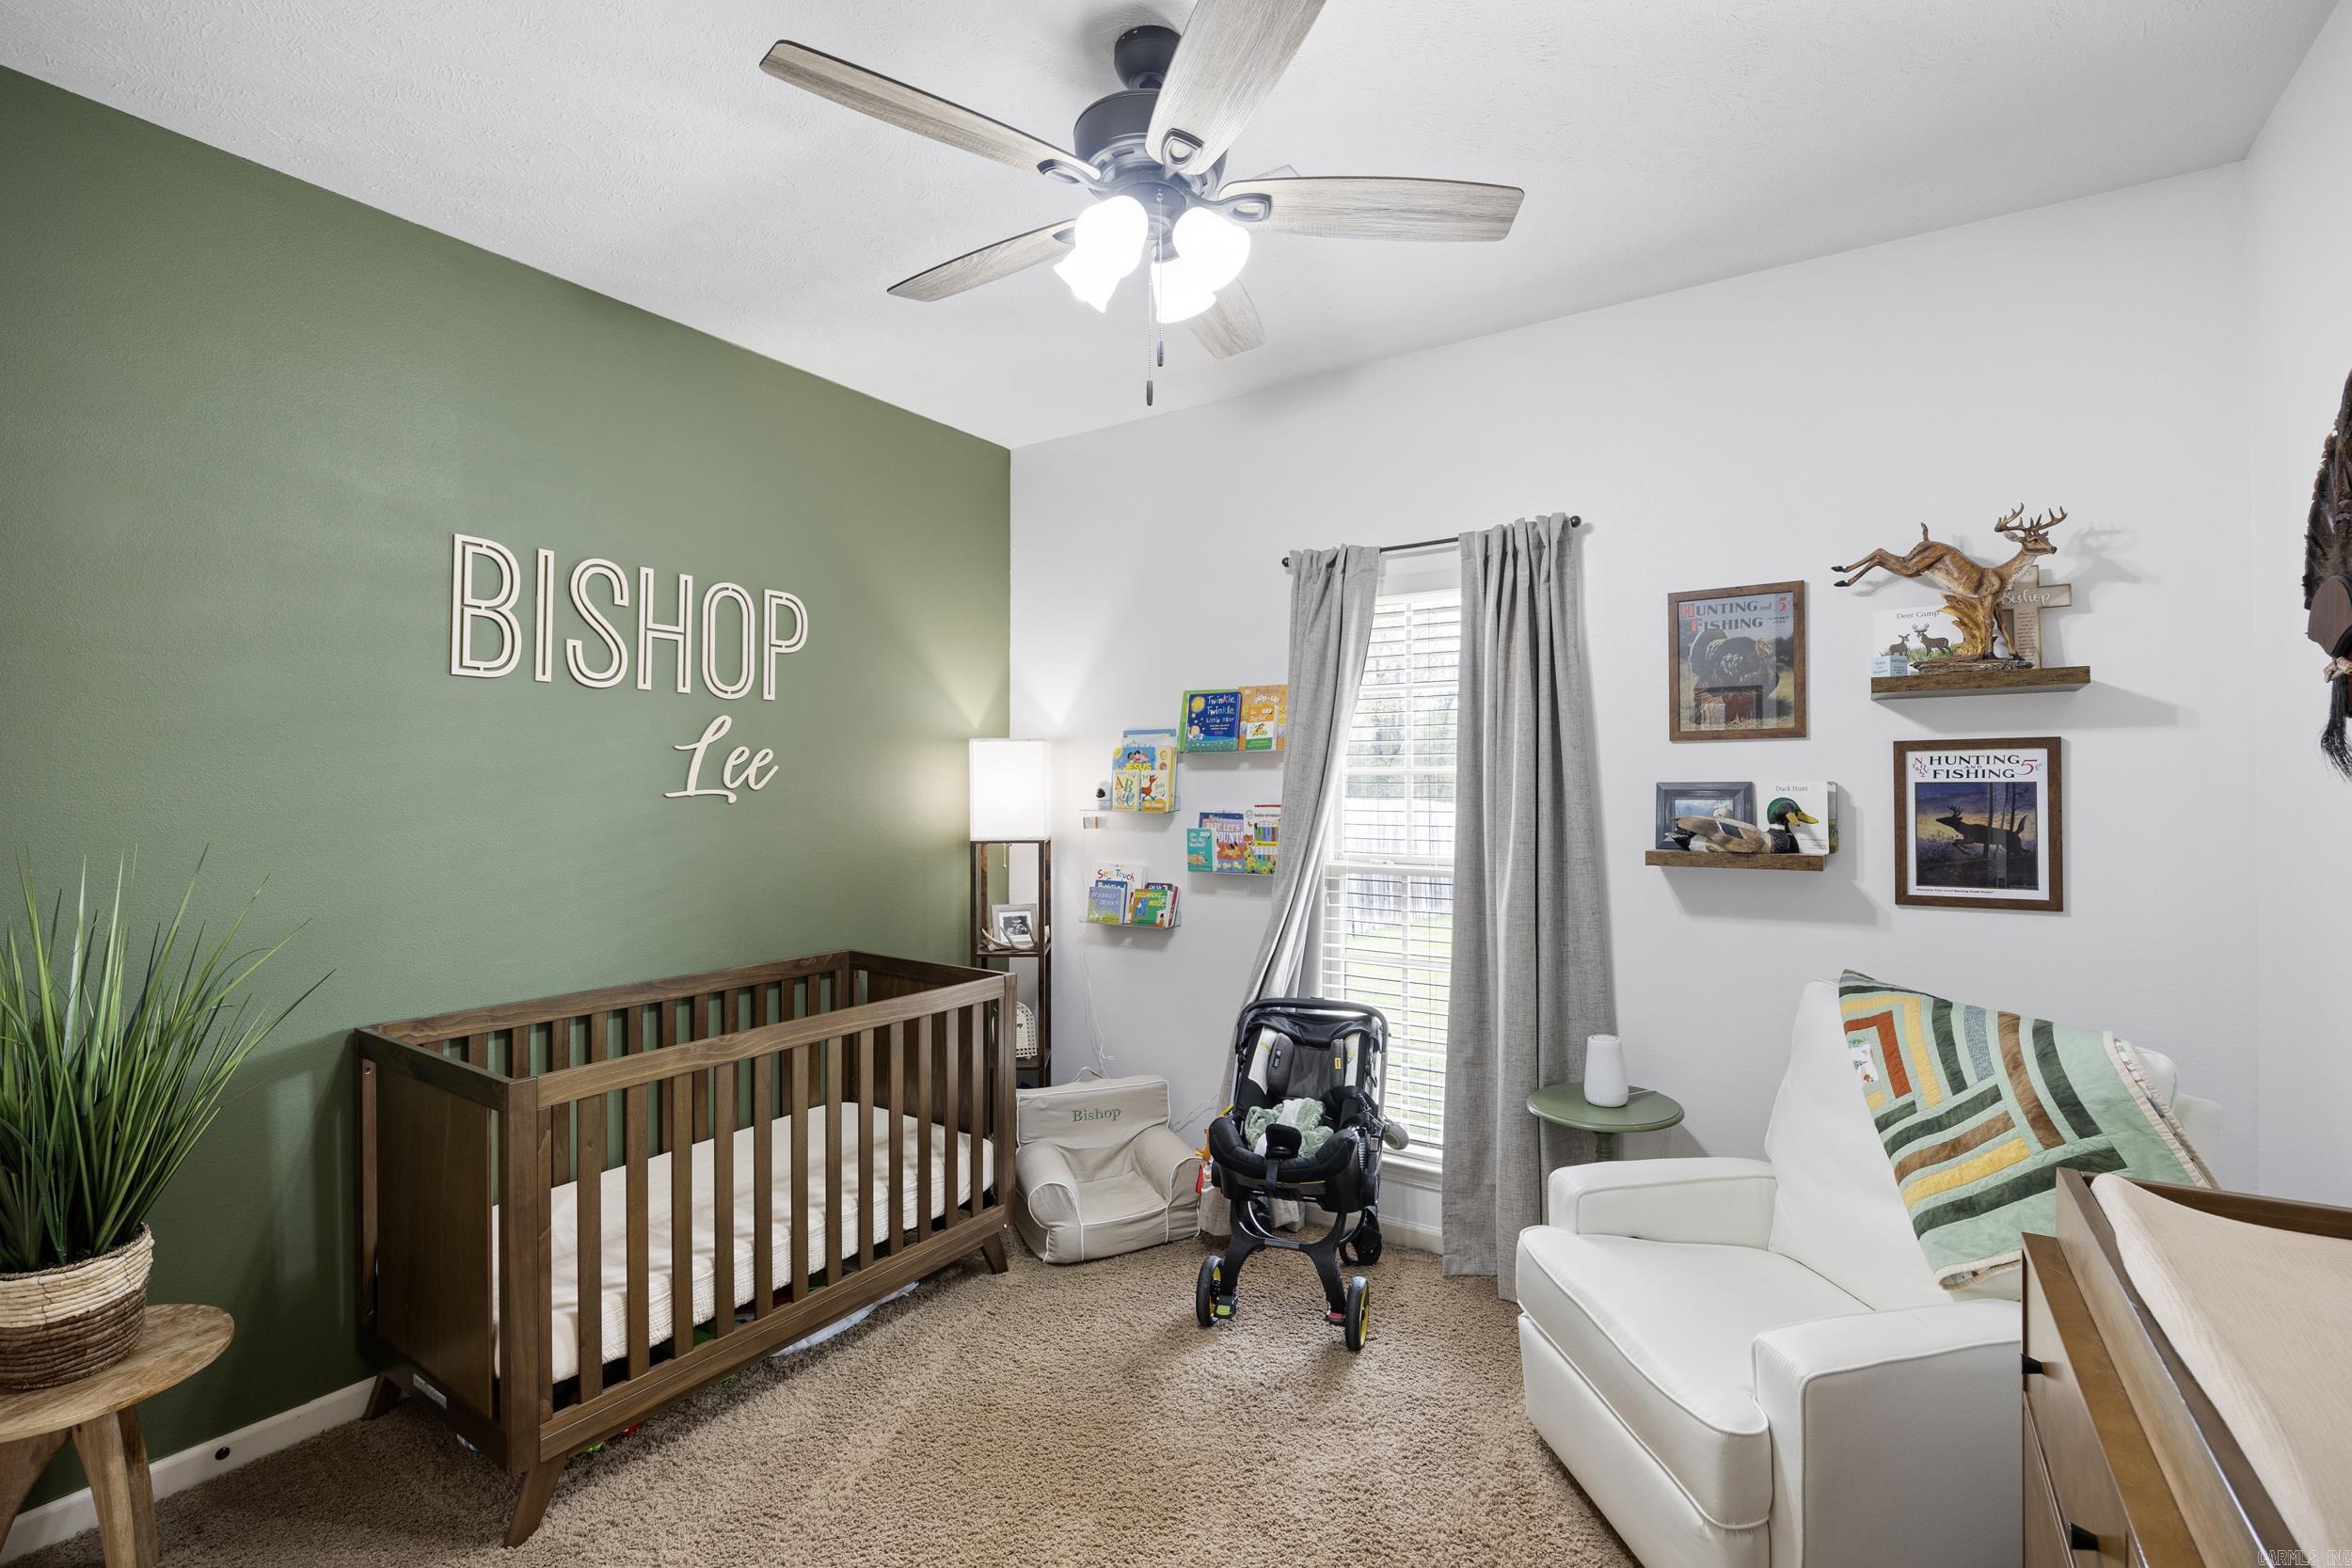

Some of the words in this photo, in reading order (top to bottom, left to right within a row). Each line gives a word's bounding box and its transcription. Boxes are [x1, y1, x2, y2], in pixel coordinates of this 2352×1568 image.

[2001, 589, 2051, 606] Bishop
[450, 533, 809, 701] BISHOP
[1679, 601, 1758, 619] HUNTING
[1691, 616, 1763, 632] FISHING
[1207, 695, 1235, 705] Twinkle,
[1207, 705, 1235, 715] Twinkle,
[663, 715, 779, 803] Lee
[1929, 754, 2020, 766] HUNTING
[1932, 768, 2015, 779] FISHING
[1216, 831, 1244, 843] OUNT!
[1073, 1108, 1121, 1122] Bishop
